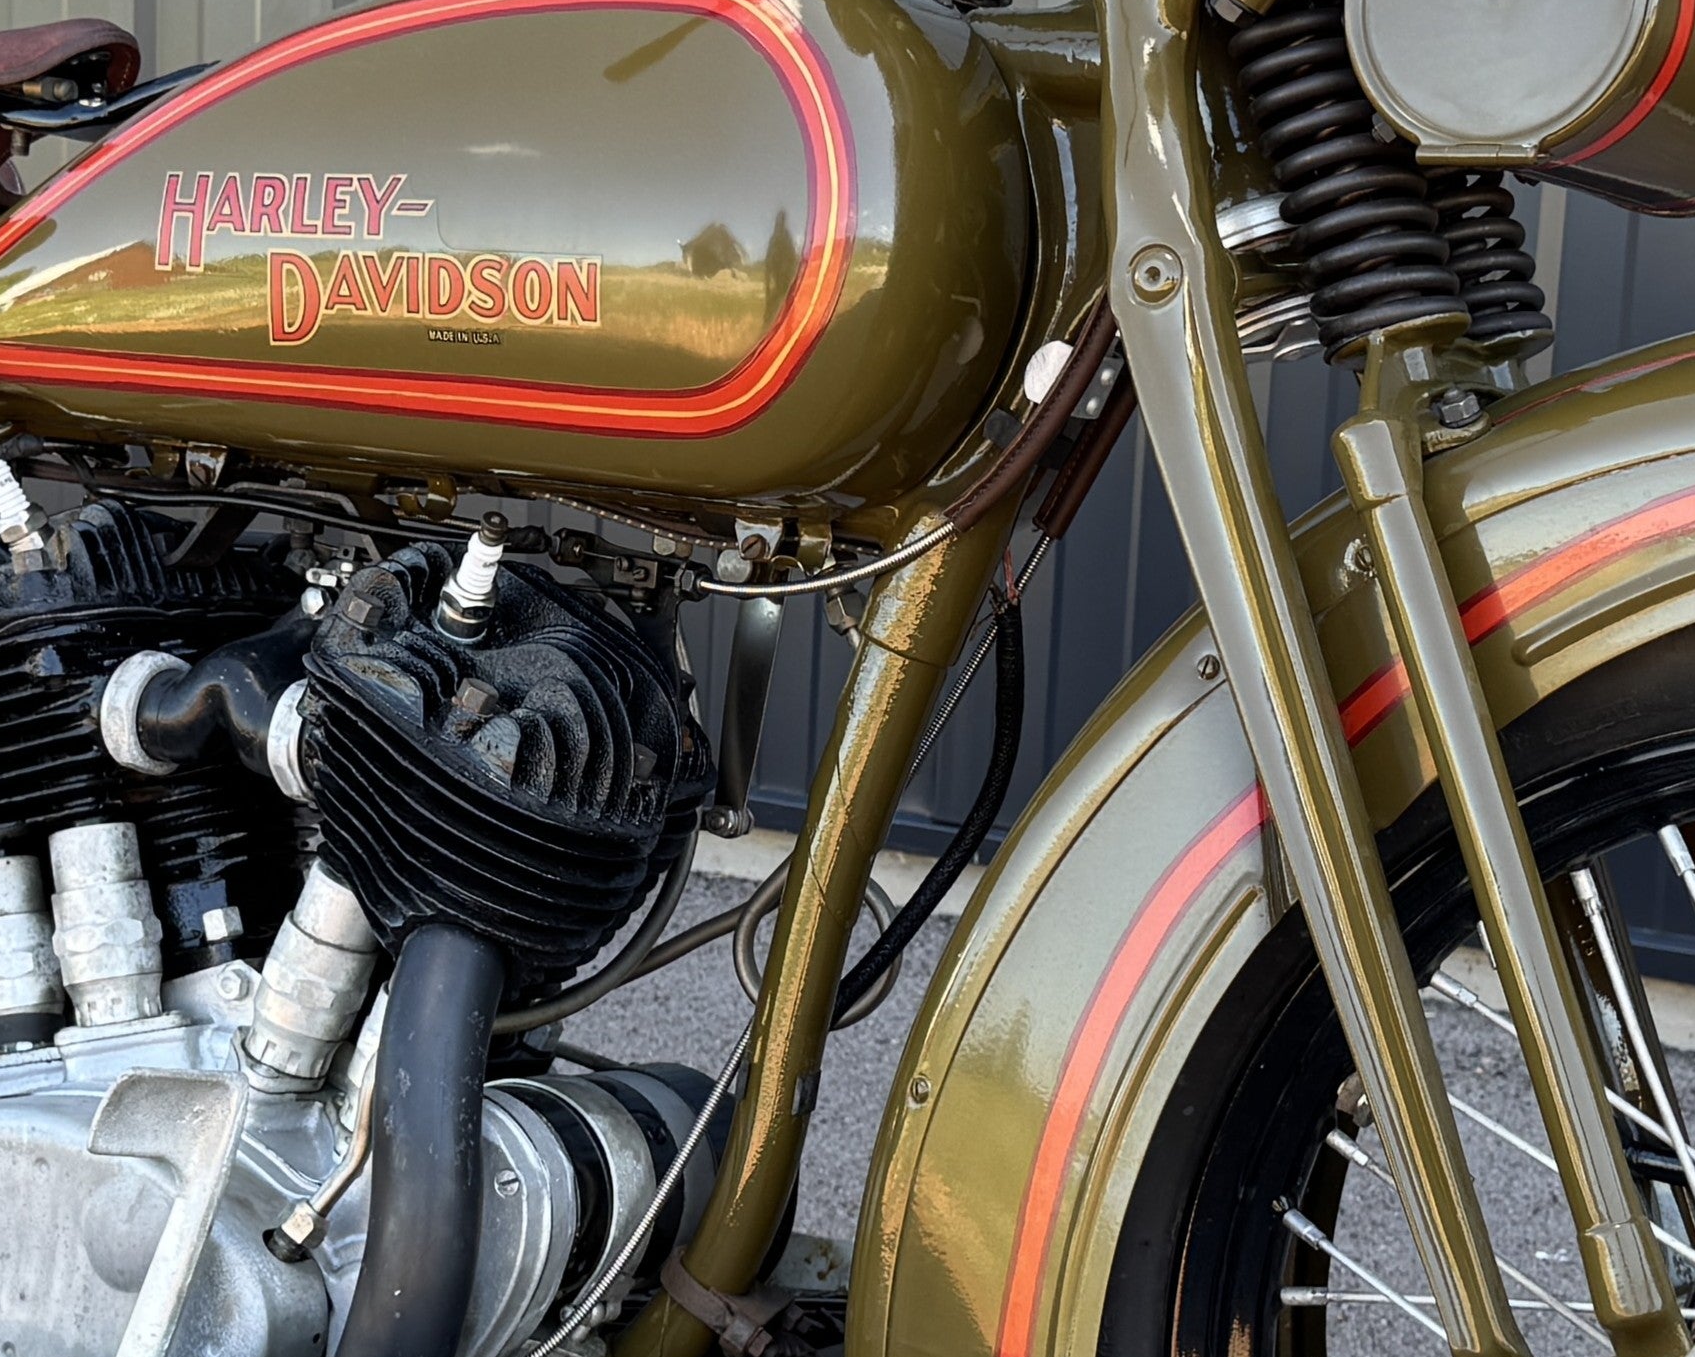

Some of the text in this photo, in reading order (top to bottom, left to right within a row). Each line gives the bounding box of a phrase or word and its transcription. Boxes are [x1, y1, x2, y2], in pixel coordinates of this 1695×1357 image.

[155, 171, 435, 272] HARLEY-
[268, 248, 601, 345] DAVIDSON
[427, 329, 455, 342] MADE
[457, 331, 469, 343] IN
